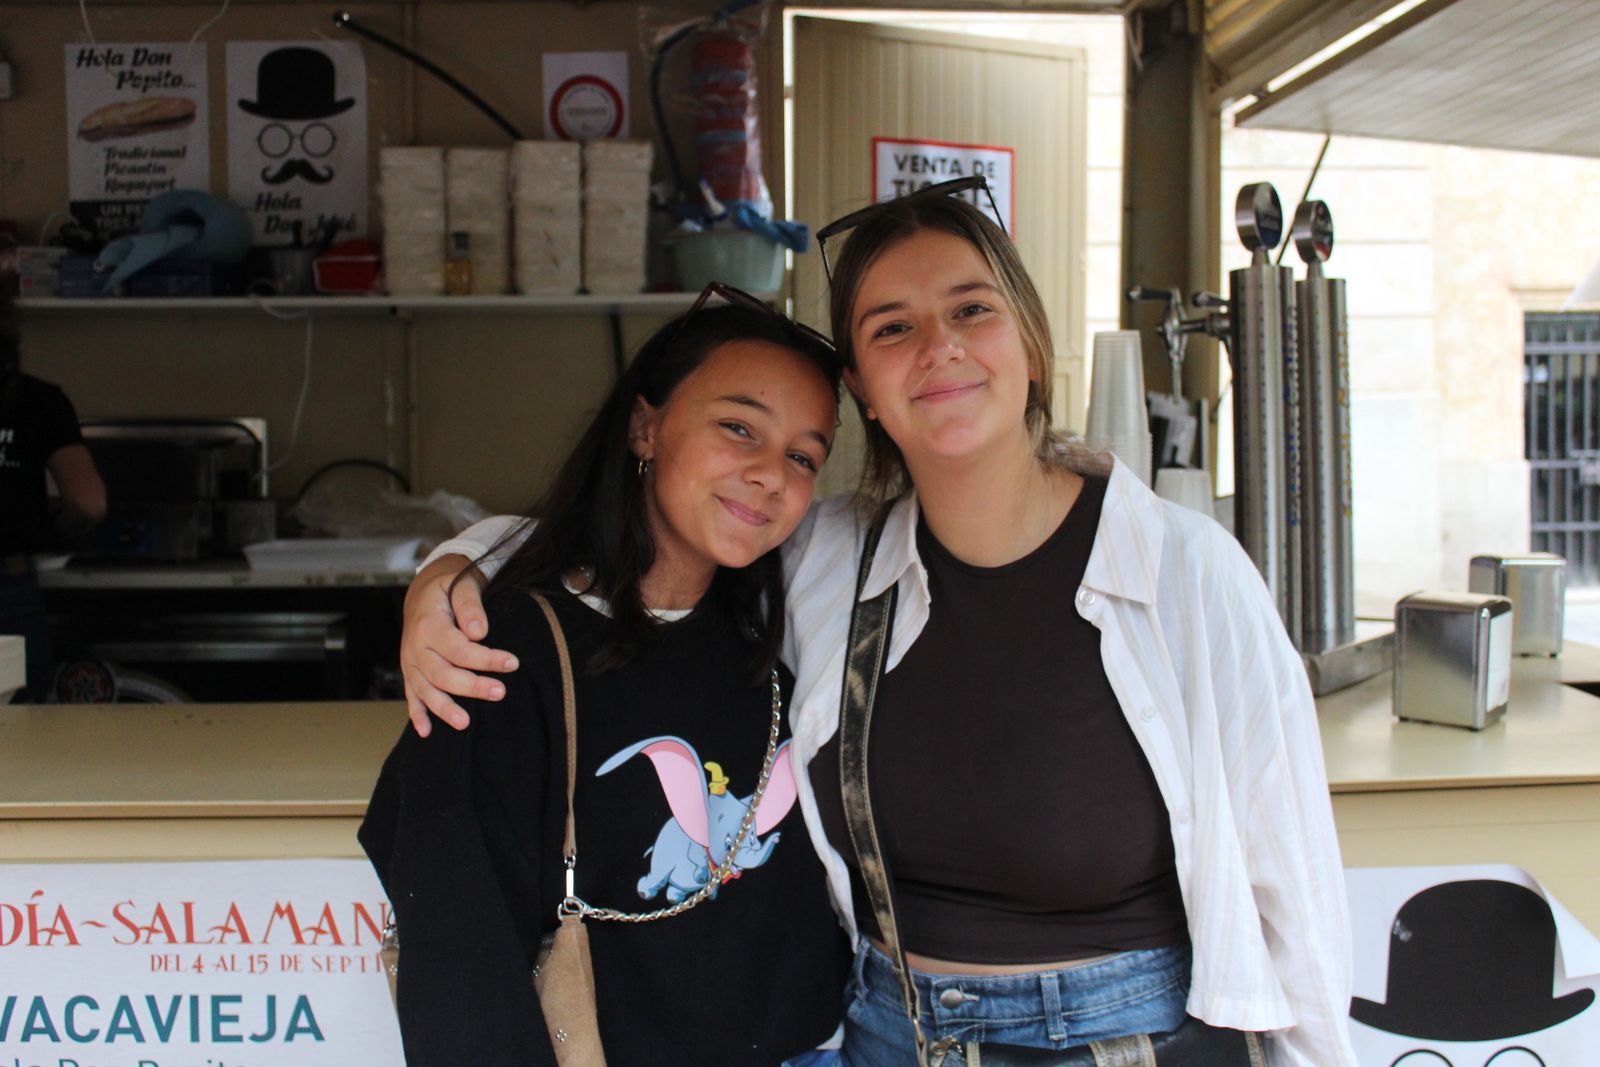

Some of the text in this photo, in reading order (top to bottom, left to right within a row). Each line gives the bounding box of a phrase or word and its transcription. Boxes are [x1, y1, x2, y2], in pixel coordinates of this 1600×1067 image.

[76, 46, 172, 68] Hola Don
[893, 153, 996, 178] VENTA DE
[255, 191, 301, 212] Hola
[264, 213, 302, 234] Do
[150, 954, 185, 974] DEL
[192, 953, 205, 974] 4
[213, 953, 241, 974] AL
[247, 953, 269, 974] 15
[280, 953, 302, 974] DE
